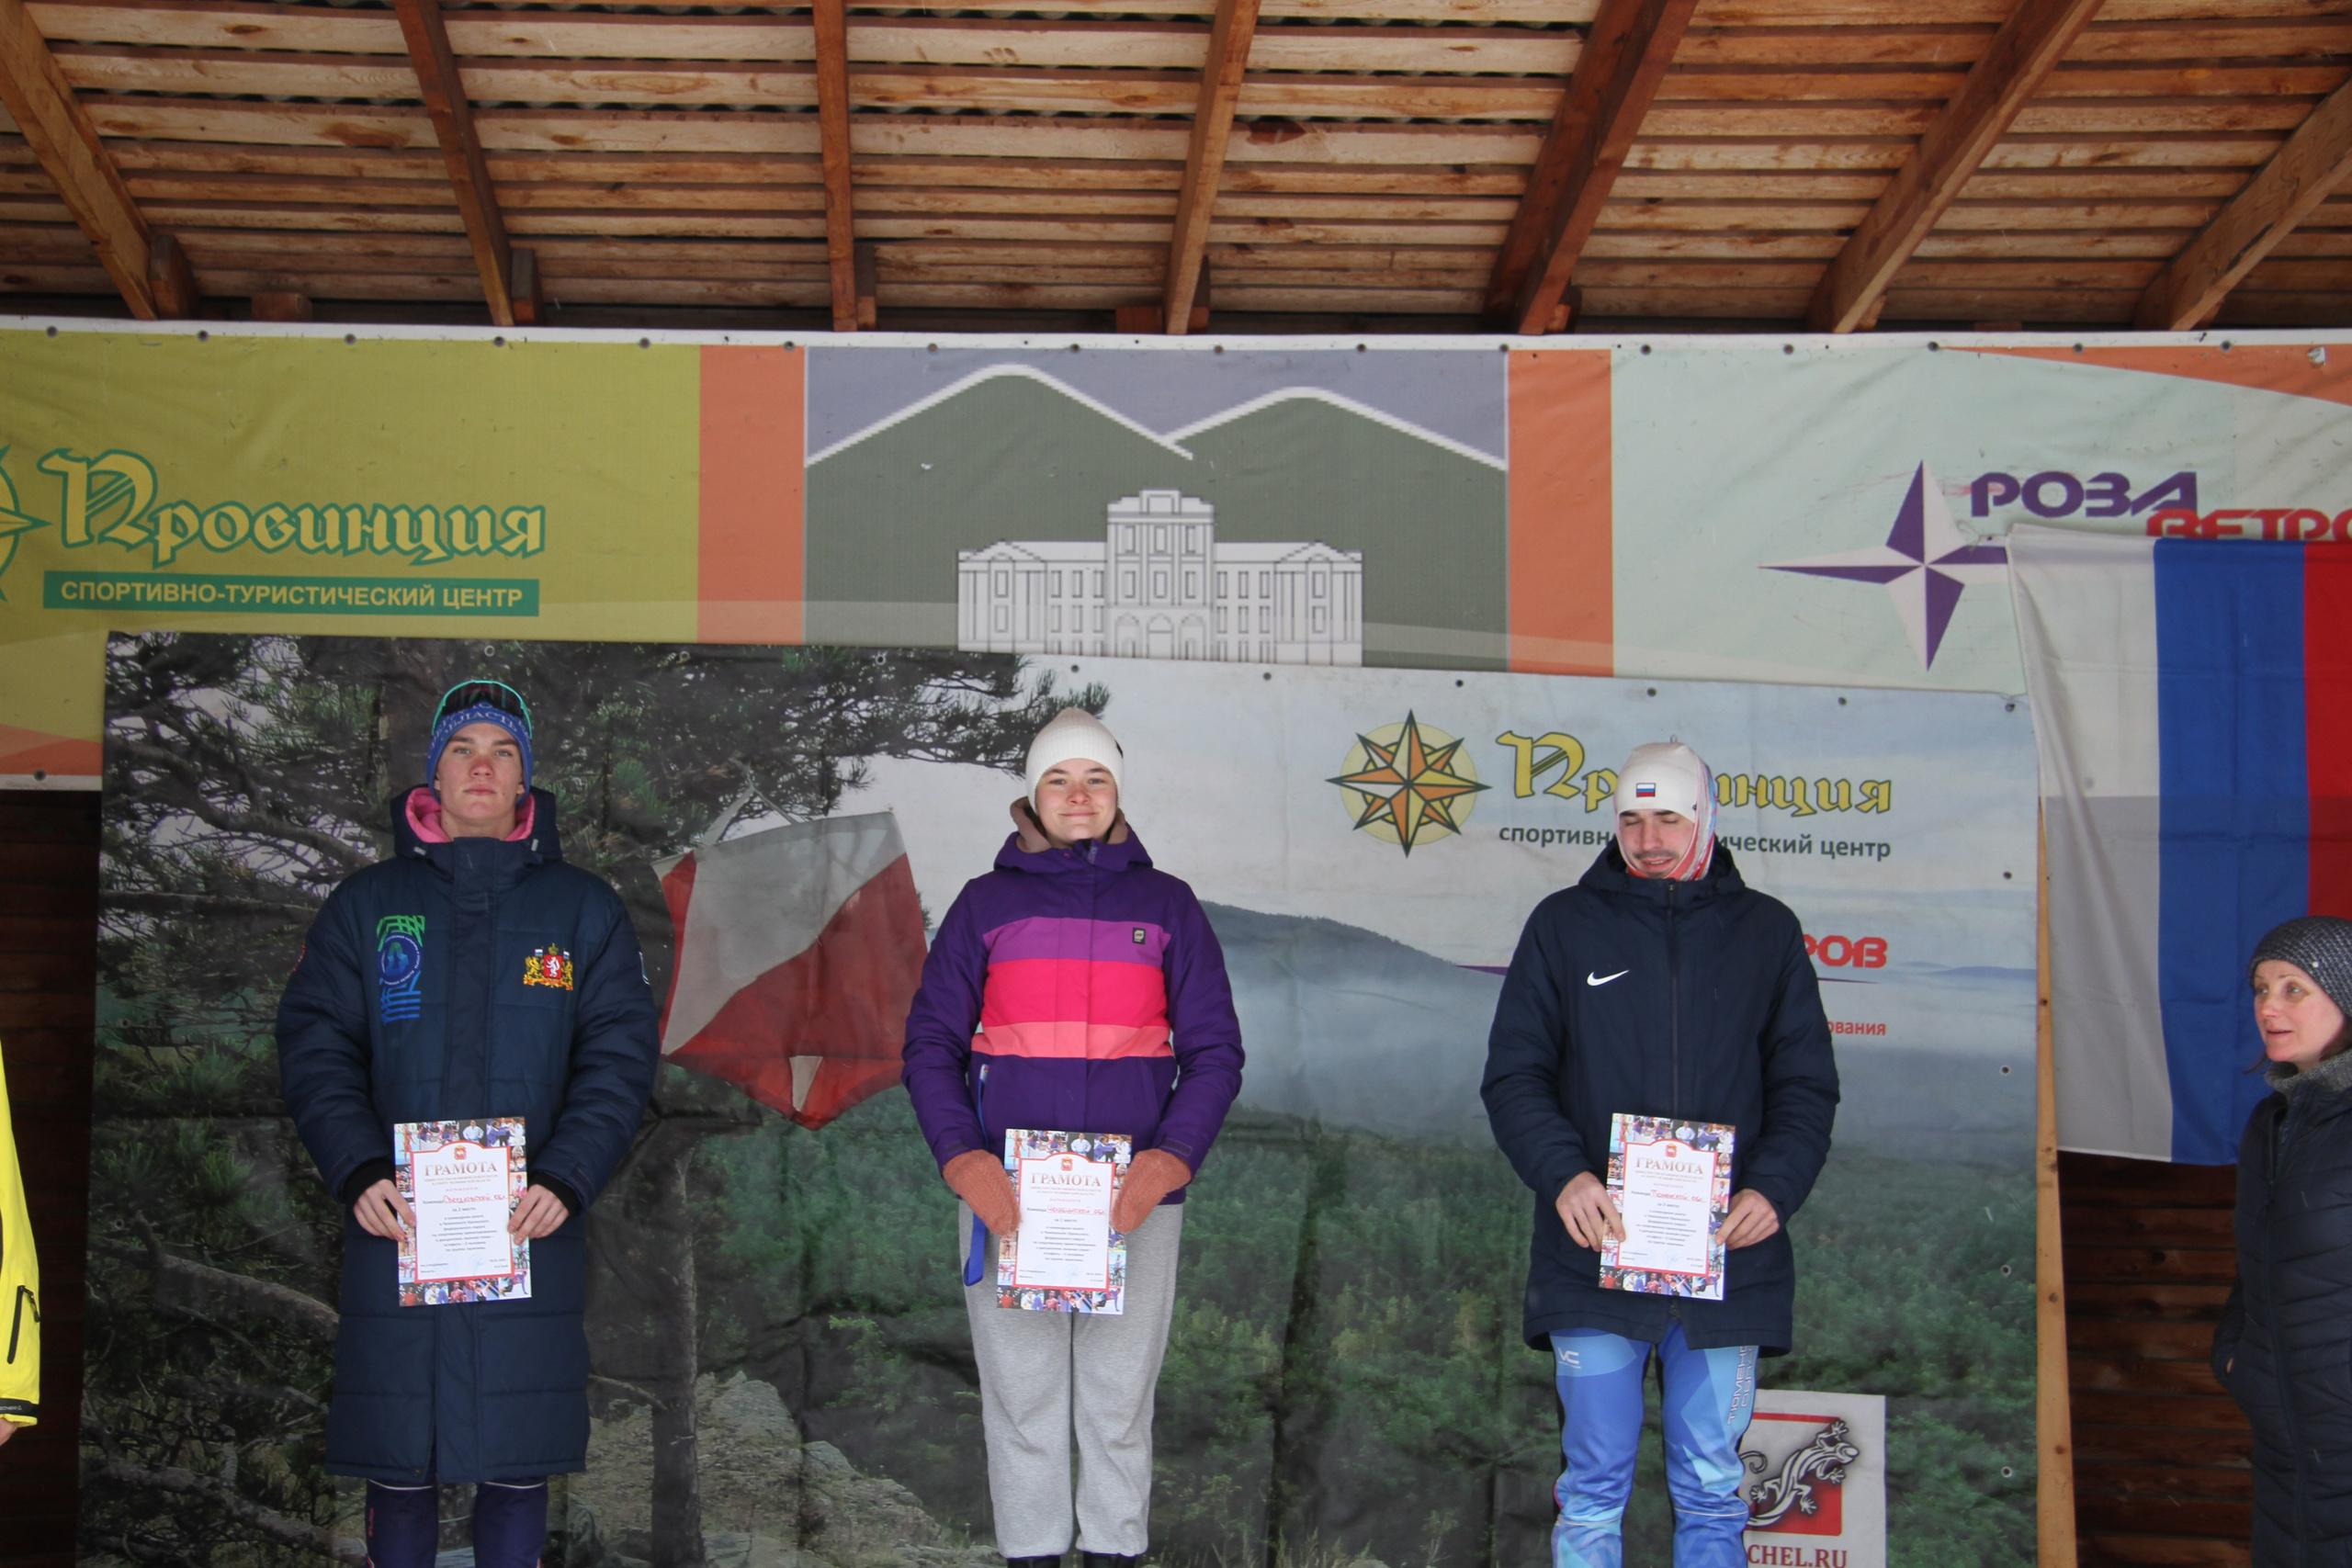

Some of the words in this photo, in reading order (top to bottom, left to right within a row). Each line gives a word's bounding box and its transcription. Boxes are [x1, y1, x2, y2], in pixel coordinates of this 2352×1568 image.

[1971, 471, 2198, 518] РОЗА
[37, 447, 546, 570] Провинция
[60, 580, 434, 608] СПОРТИВНО-ТУРИСТИЧЕСКИЙ
[442, 586, 524, 609] ЦЕНТР
[1820, 839, 1891, 862] центр
[1827, 1021, 1887, 1036] ования
[424, 1161, 498, 1177] ГРАМОТА
[1635, 1156, 1703, 1175] ГРАМОТА
[1031, 1172, 1102, 1188] ГРАМОТА
